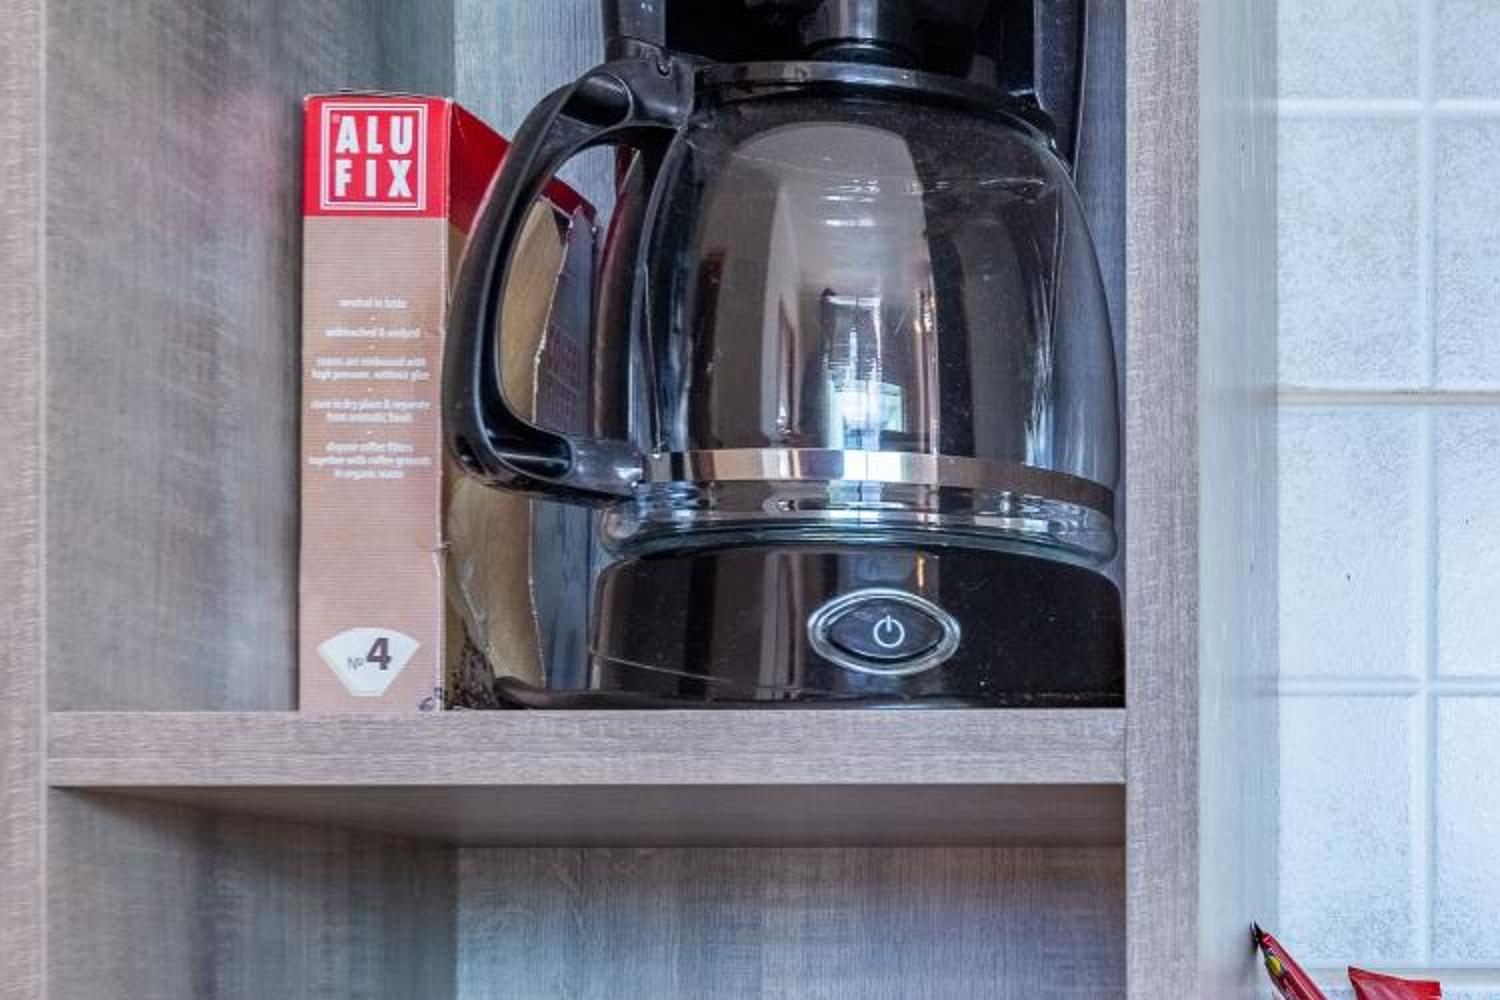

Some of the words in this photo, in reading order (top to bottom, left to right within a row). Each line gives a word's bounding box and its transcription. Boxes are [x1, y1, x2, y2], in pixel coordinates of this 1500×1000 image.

[335, 114, 414, 154] ALU
[333, 158, 414, 198] FIX
[365, 637, 392, 671] 4
